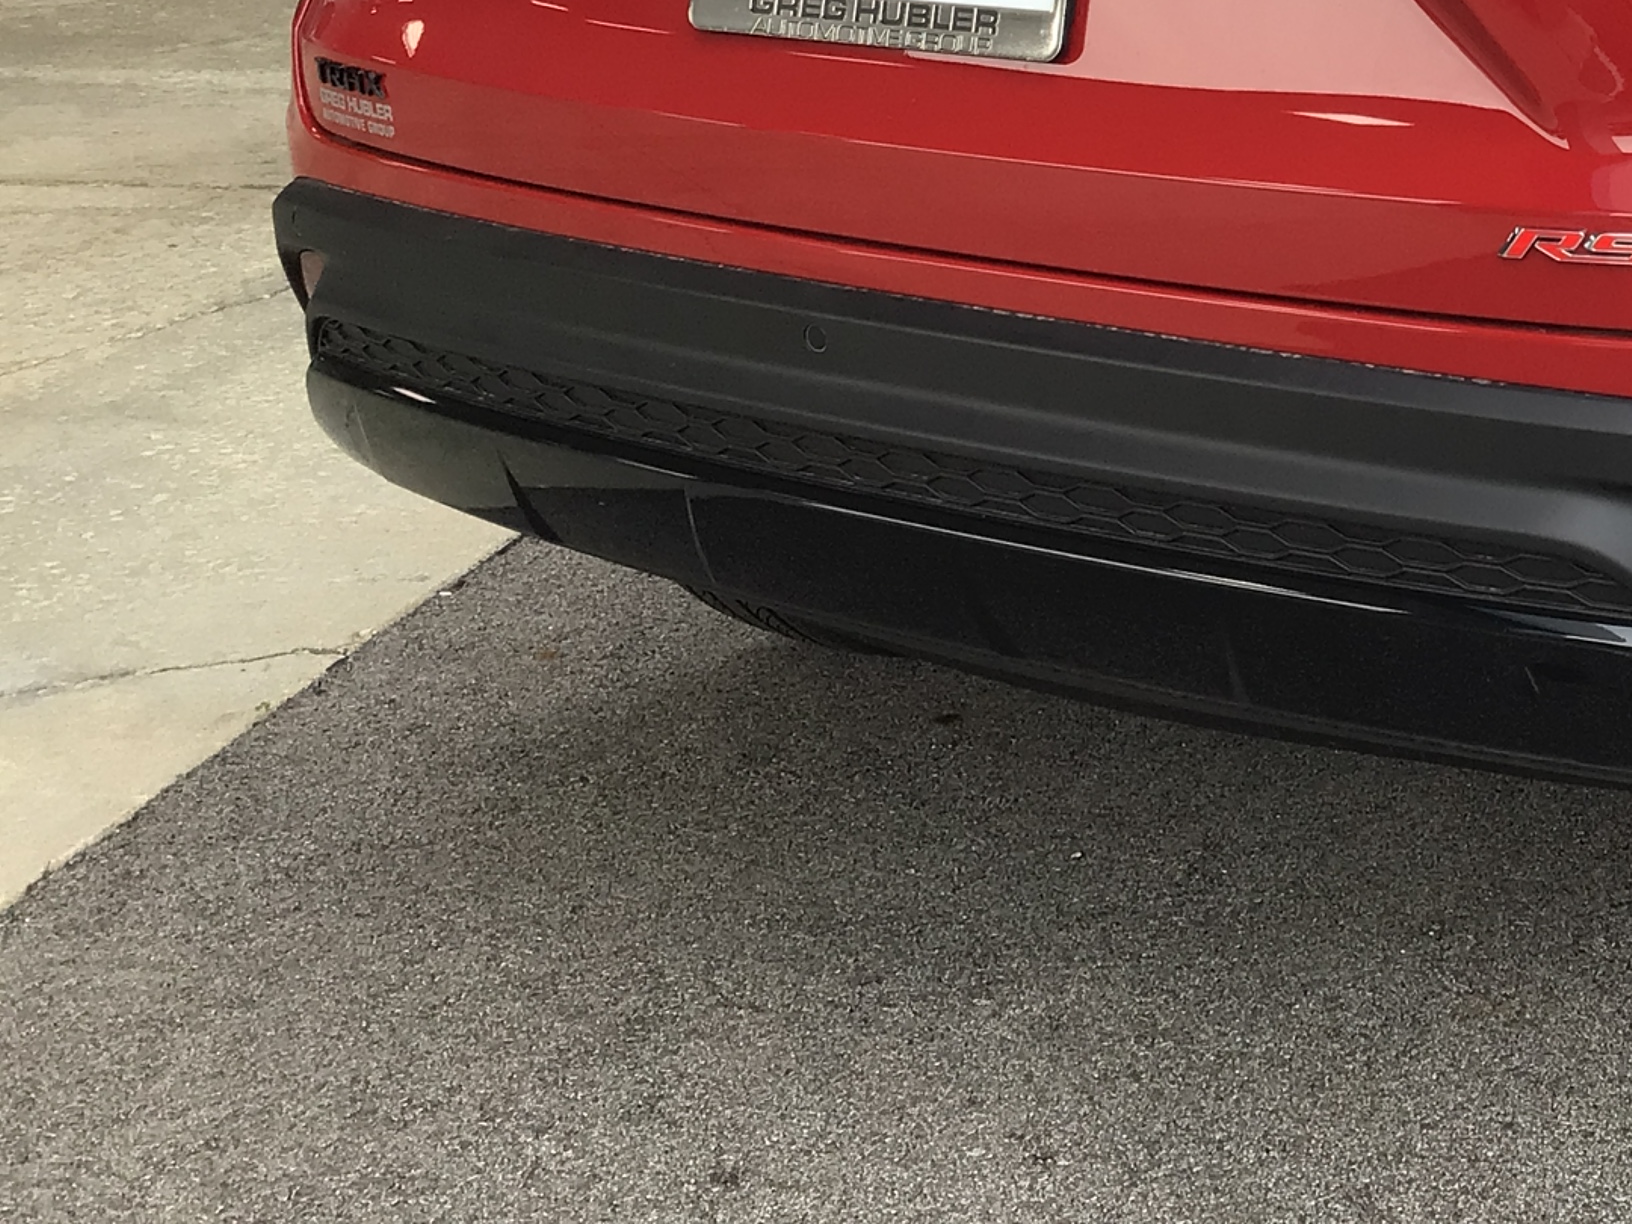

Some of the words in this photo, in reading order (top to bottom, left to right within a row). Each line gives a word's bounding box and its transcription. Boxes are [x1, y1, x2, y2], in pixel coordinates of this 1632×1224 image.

[750, 16, 903, 48] AUTOMOTIVE
[902, 30, 995, 55] GROUP
[314, 56, 389, 99] TRAX
[346, 96, 394, 122] HUBLER
